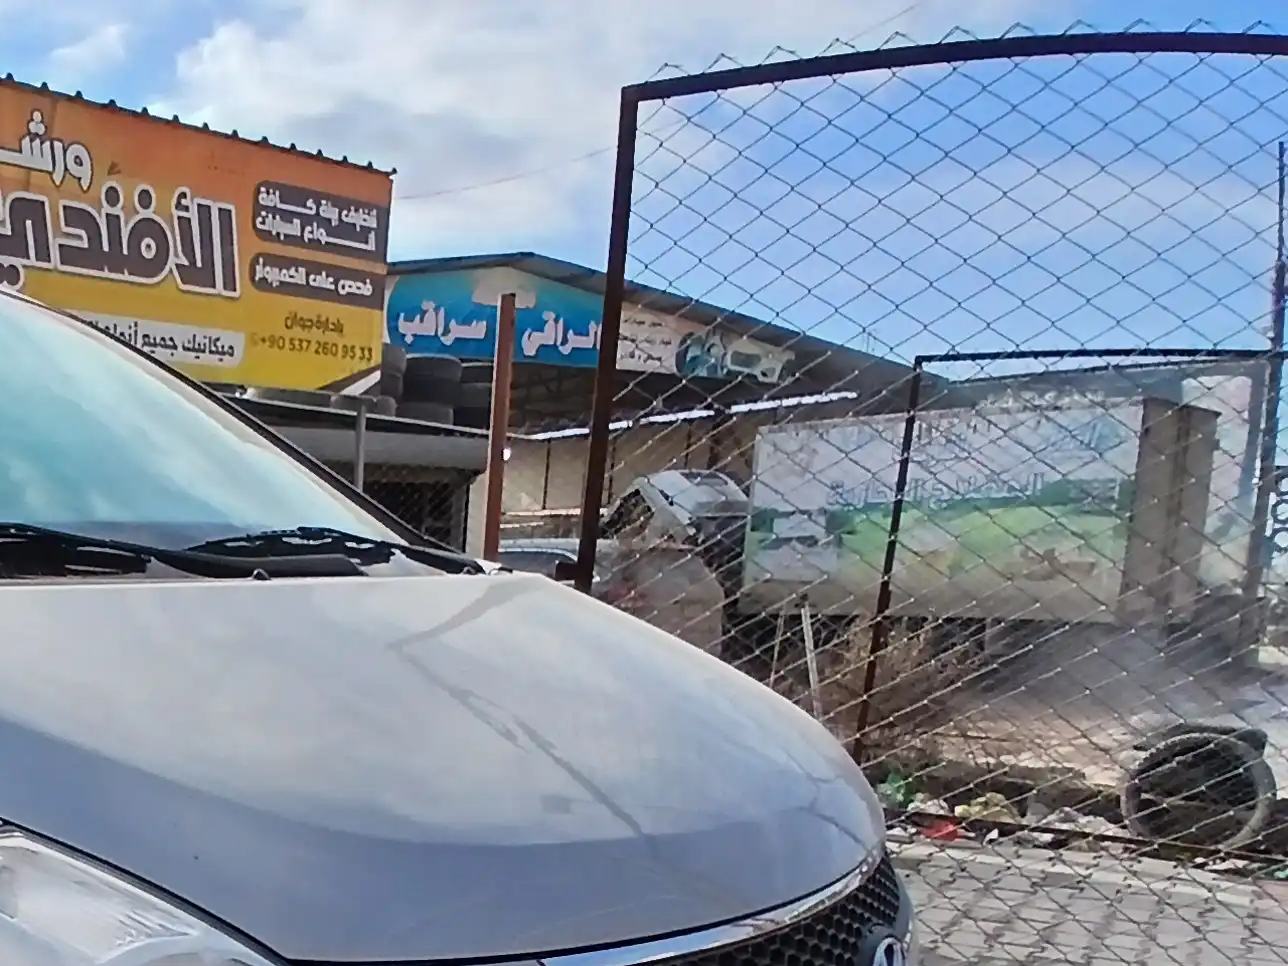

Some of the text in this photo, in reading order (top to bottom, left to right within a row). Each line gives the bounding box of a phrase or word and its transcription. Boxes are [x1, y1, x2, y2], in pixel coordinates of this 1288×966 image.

[338, 278, 373, 296] فحص
[398, 300, 487, 346] سراقب
[141, 332, 178, 357] جميع
[182, 333, 235, 362] ميكانيك
[260, 332, 373, 362] +90 537 260 95 33
